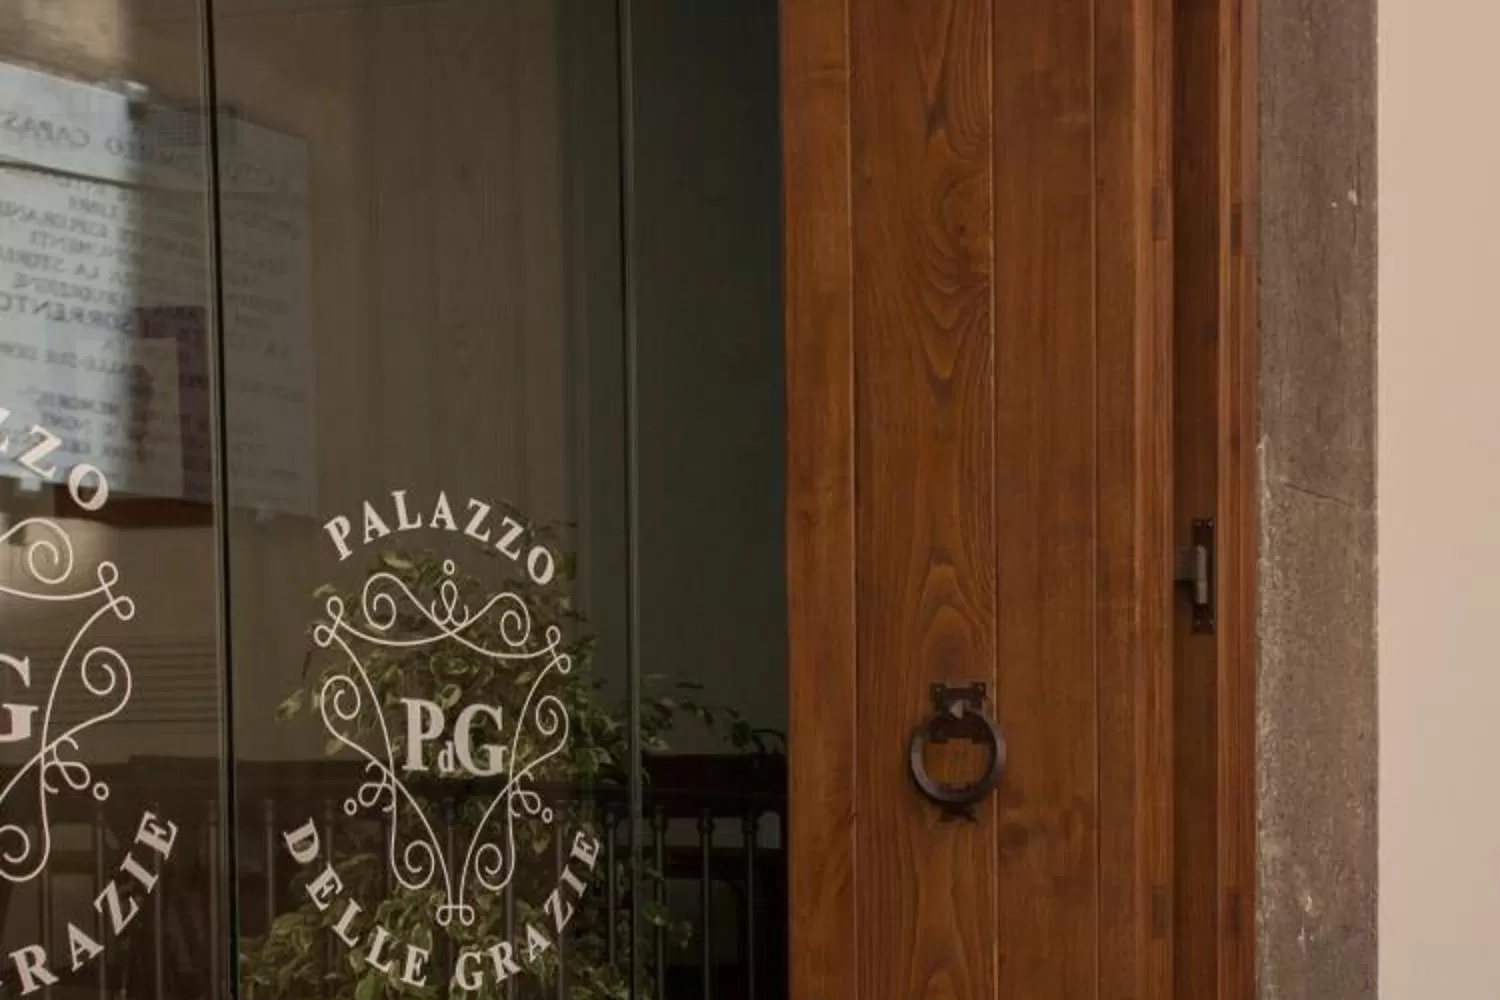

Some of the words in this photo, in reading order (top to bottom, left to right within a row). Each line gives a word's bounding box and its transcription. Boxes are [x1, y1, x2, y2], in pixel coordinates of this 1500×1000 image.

[323, 489, 555, 586] PALAZZO
[401, 697, 508, 777] PdG
[0, 811, 178, 996] RAZIE
[283, 817, 430, 988] DELLE
[455, 830, 601, 992] GRAZIE
